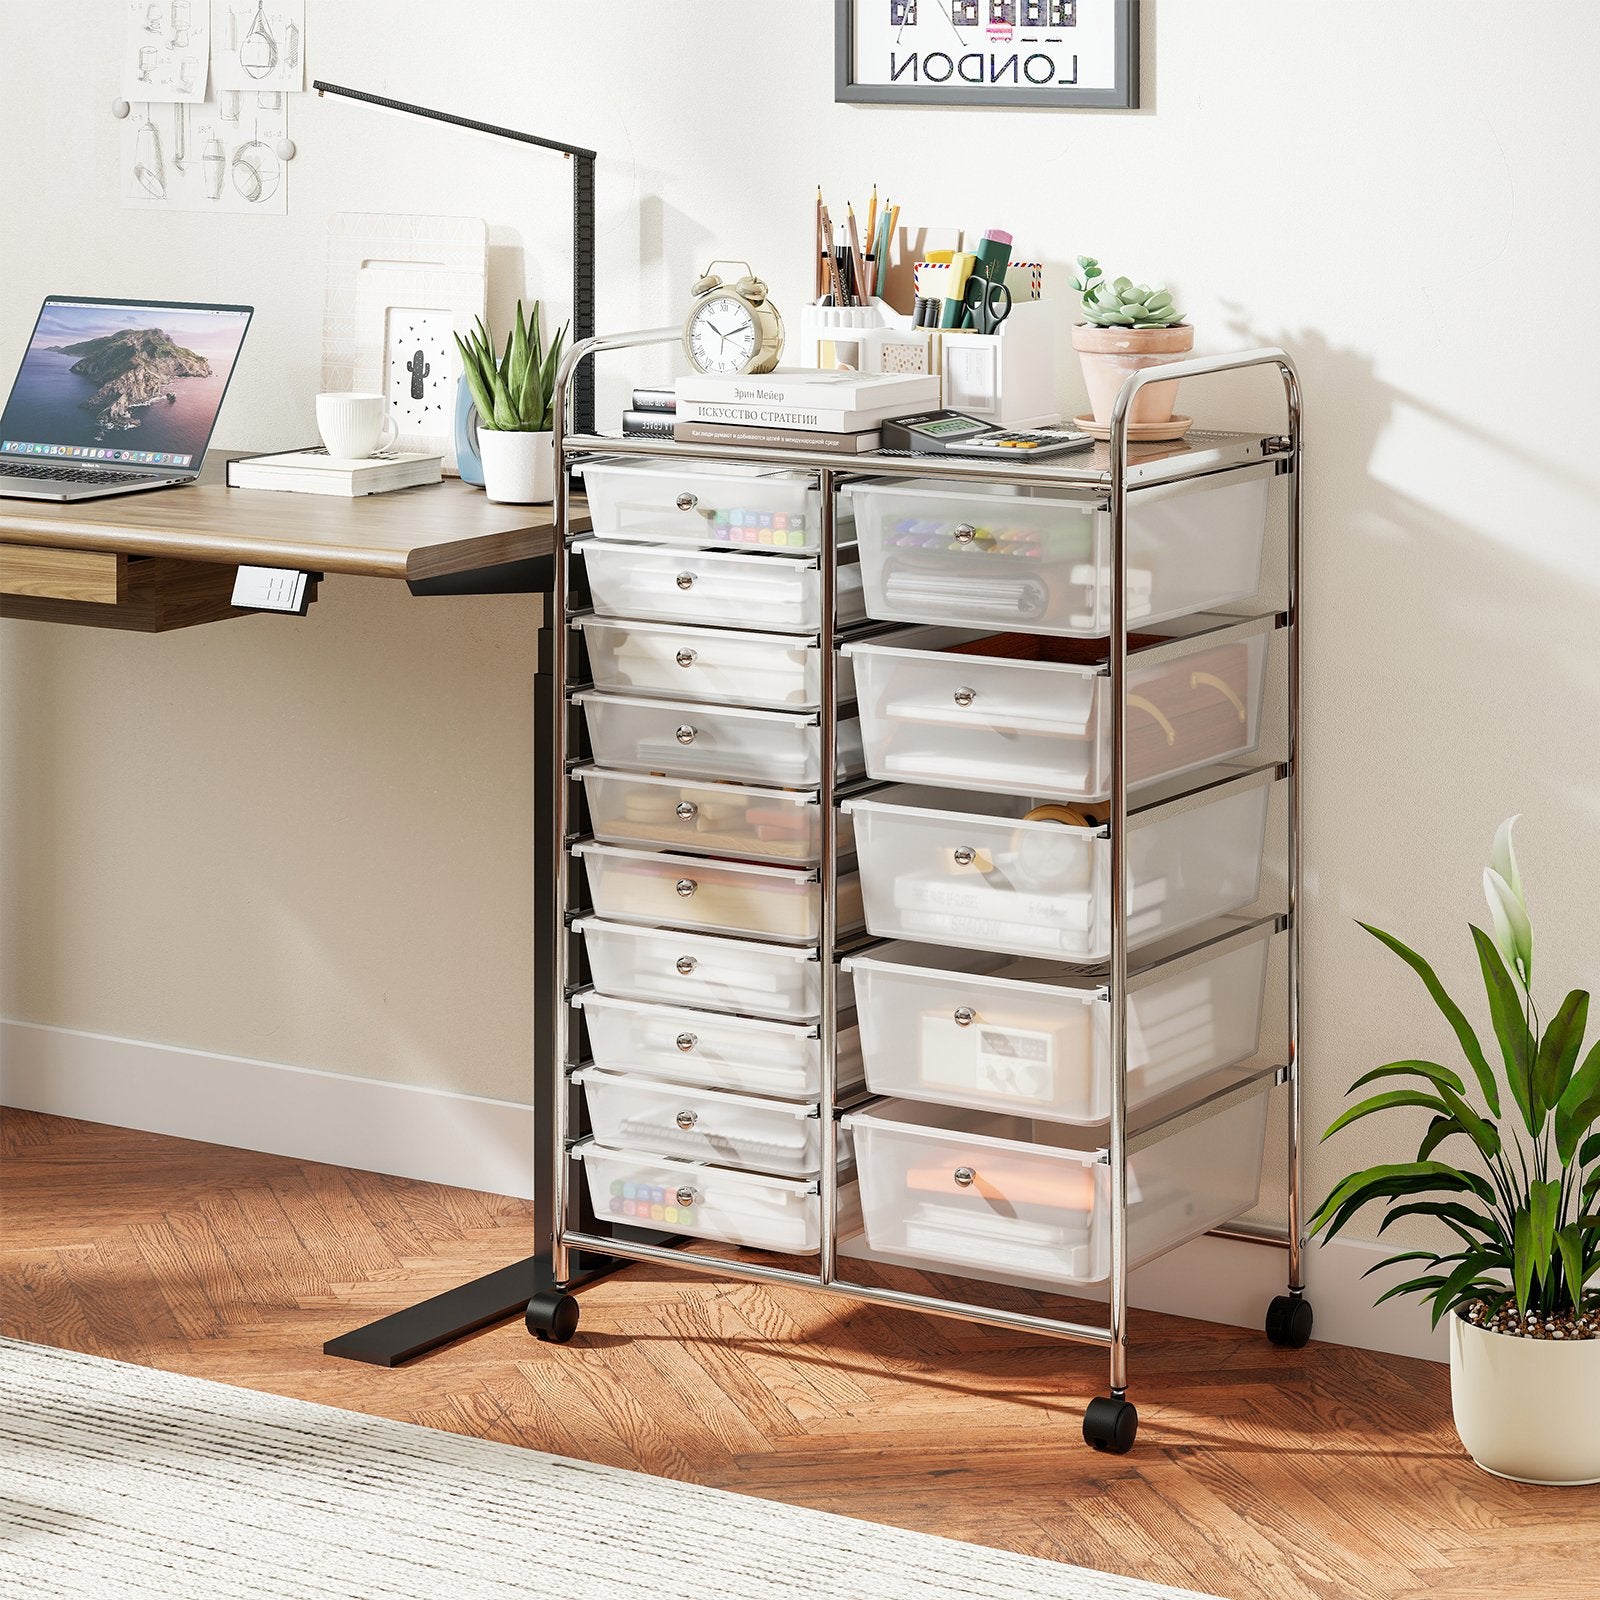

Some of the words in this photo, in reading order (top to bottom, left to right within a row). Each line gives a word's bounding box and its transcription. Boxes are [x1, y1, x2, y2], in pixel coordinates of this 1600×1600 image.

[734, 387, 755, 400] Эрин
[756, 389, 785, 402] Мейер
[698, 406, 758, 420] ИСКУССТВО
[760, 411, 818, 425] СТРАТЕГИИ
